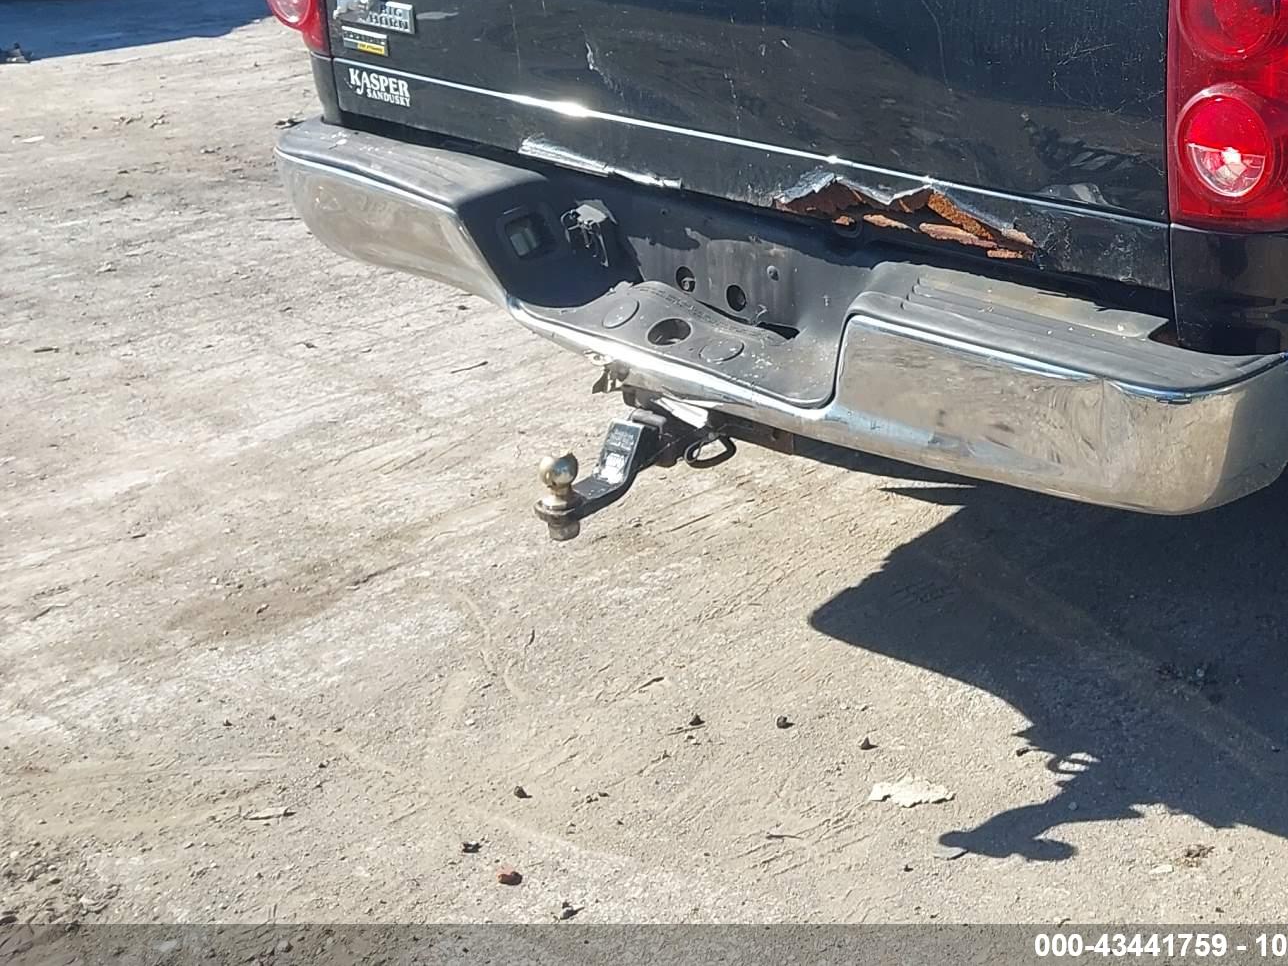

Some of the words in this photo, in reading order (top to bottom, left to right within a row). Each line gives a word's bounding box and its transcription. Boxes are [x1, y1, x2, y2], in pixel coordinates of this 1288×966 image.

[368, 14, 408, 29] HORN
[349, 68, 410, 97] KASPER
[366, 88, 410, 107] SANDUSKY
